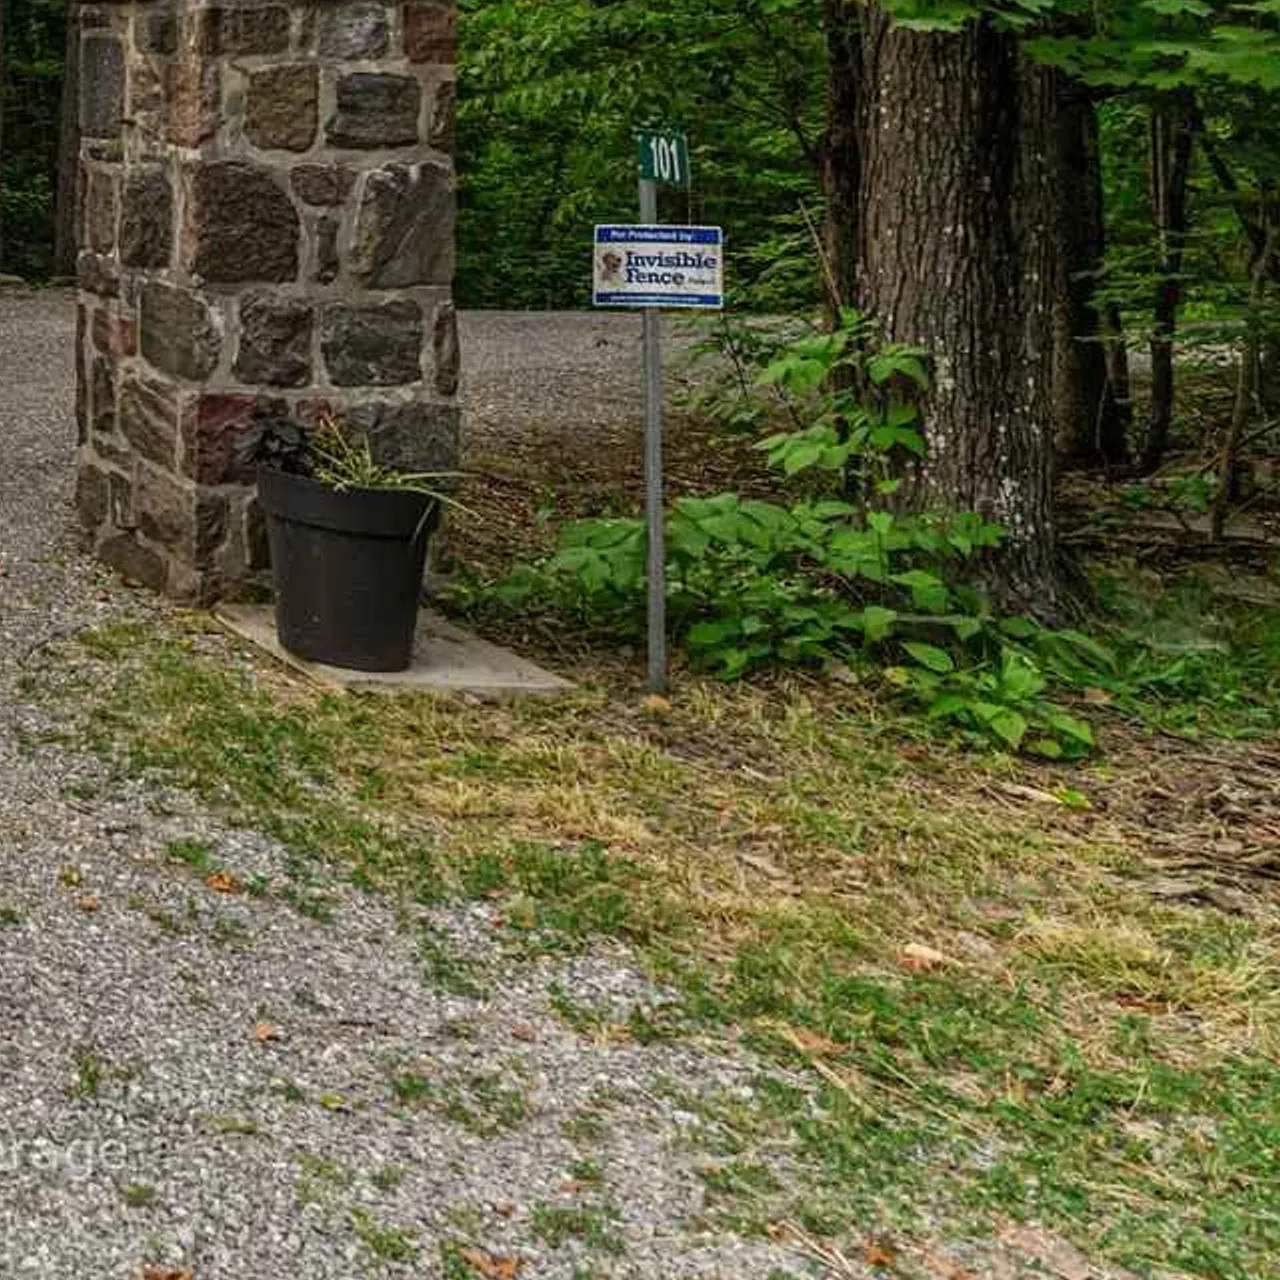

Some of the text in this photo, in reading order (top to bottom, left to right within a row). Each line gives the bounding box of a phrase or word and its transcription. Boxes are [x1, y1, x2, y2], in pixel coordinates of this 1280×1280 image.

[650, 136, 680, 181] 101
[625, 251, 716, 269] Invisible
[625, 268, 684, 285] Fence
